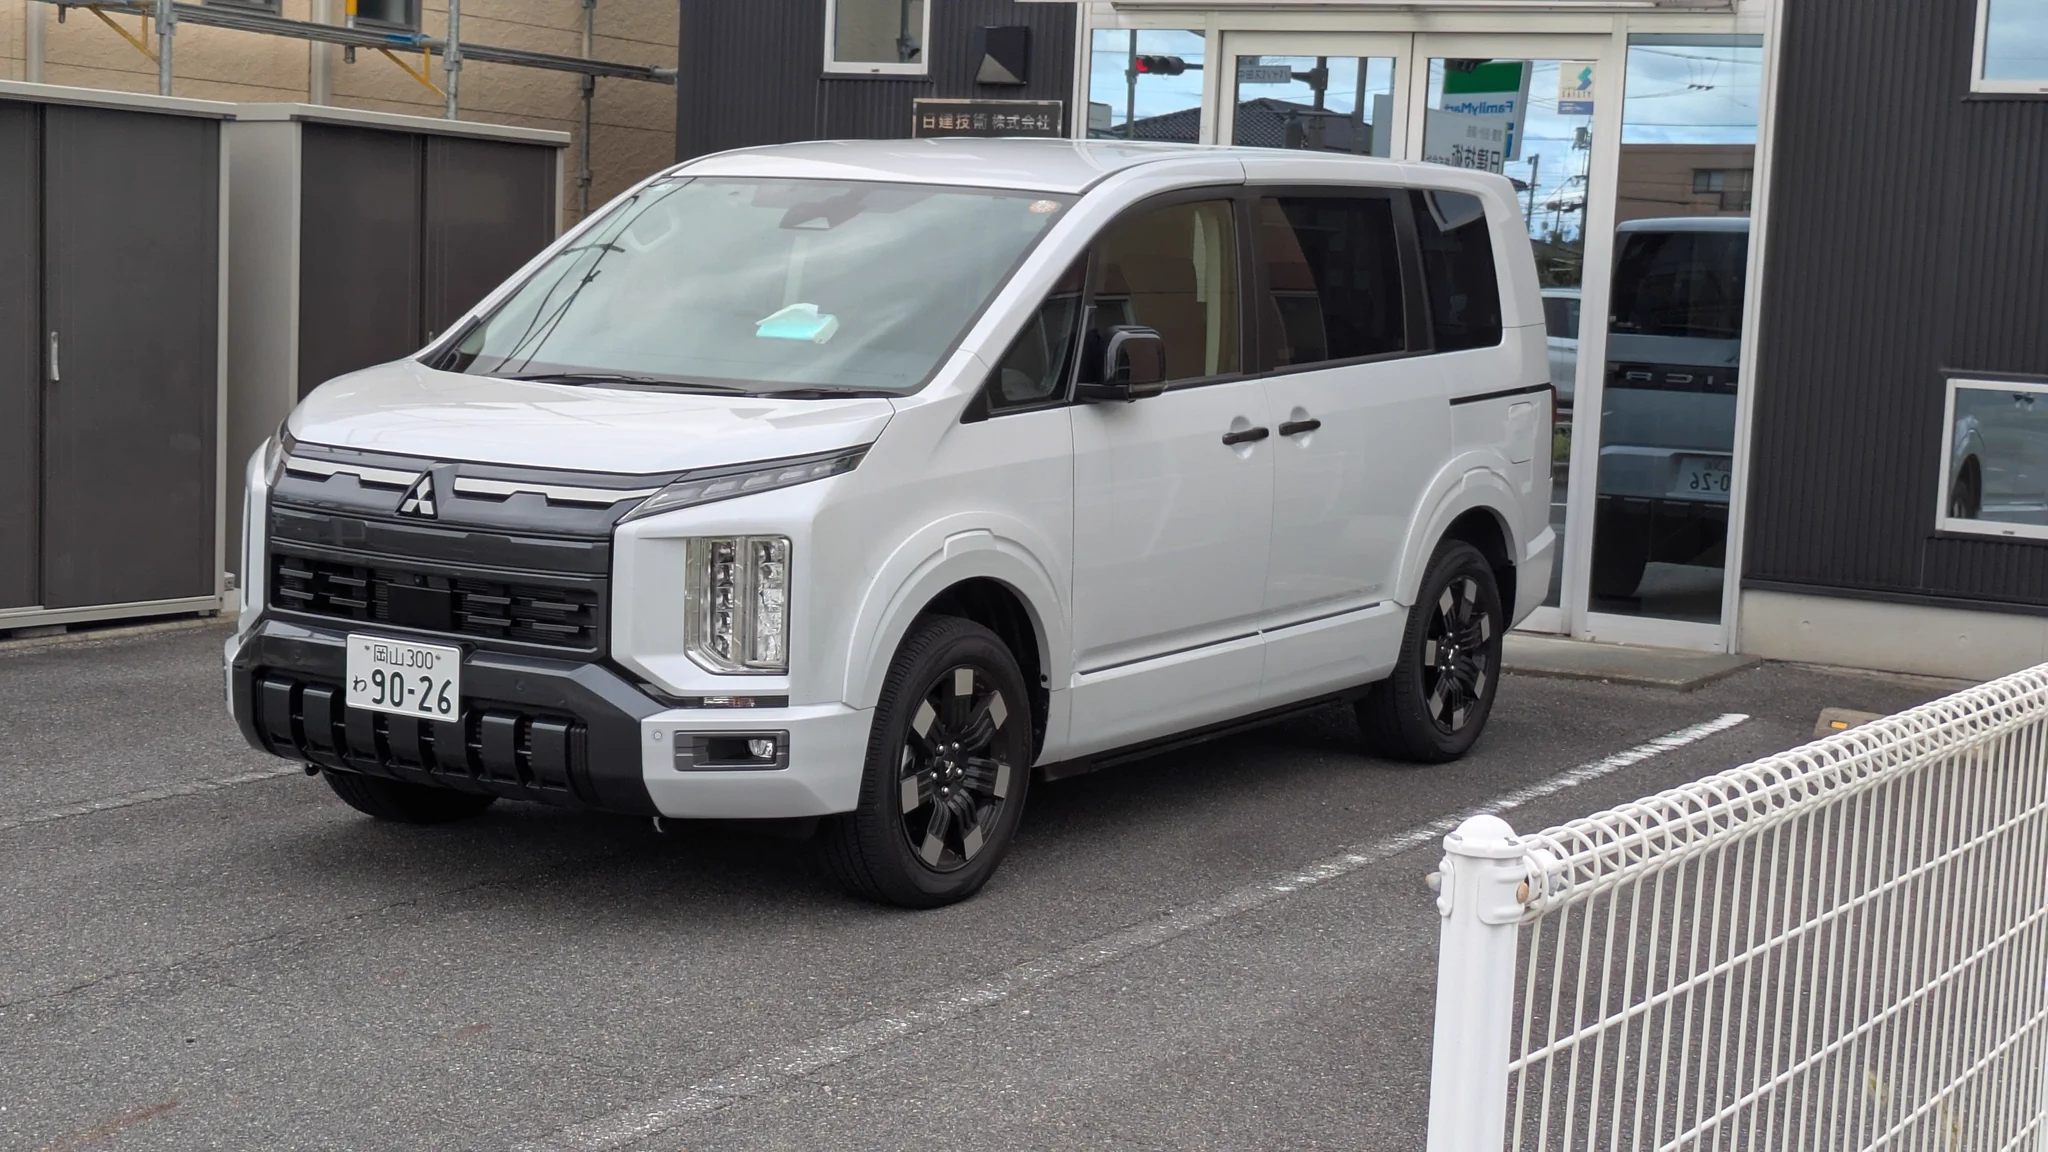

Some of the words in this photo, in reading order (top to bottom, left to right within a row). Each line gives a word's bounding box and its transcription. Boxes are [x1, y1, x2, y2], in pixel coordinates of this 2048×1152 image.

[923, 112, 988, 130] 日建技術
[992, 113, 1050, 130] 株式会社
[353, 675, 367, 692] わ
[372, 669, 452, 714] 90-26
